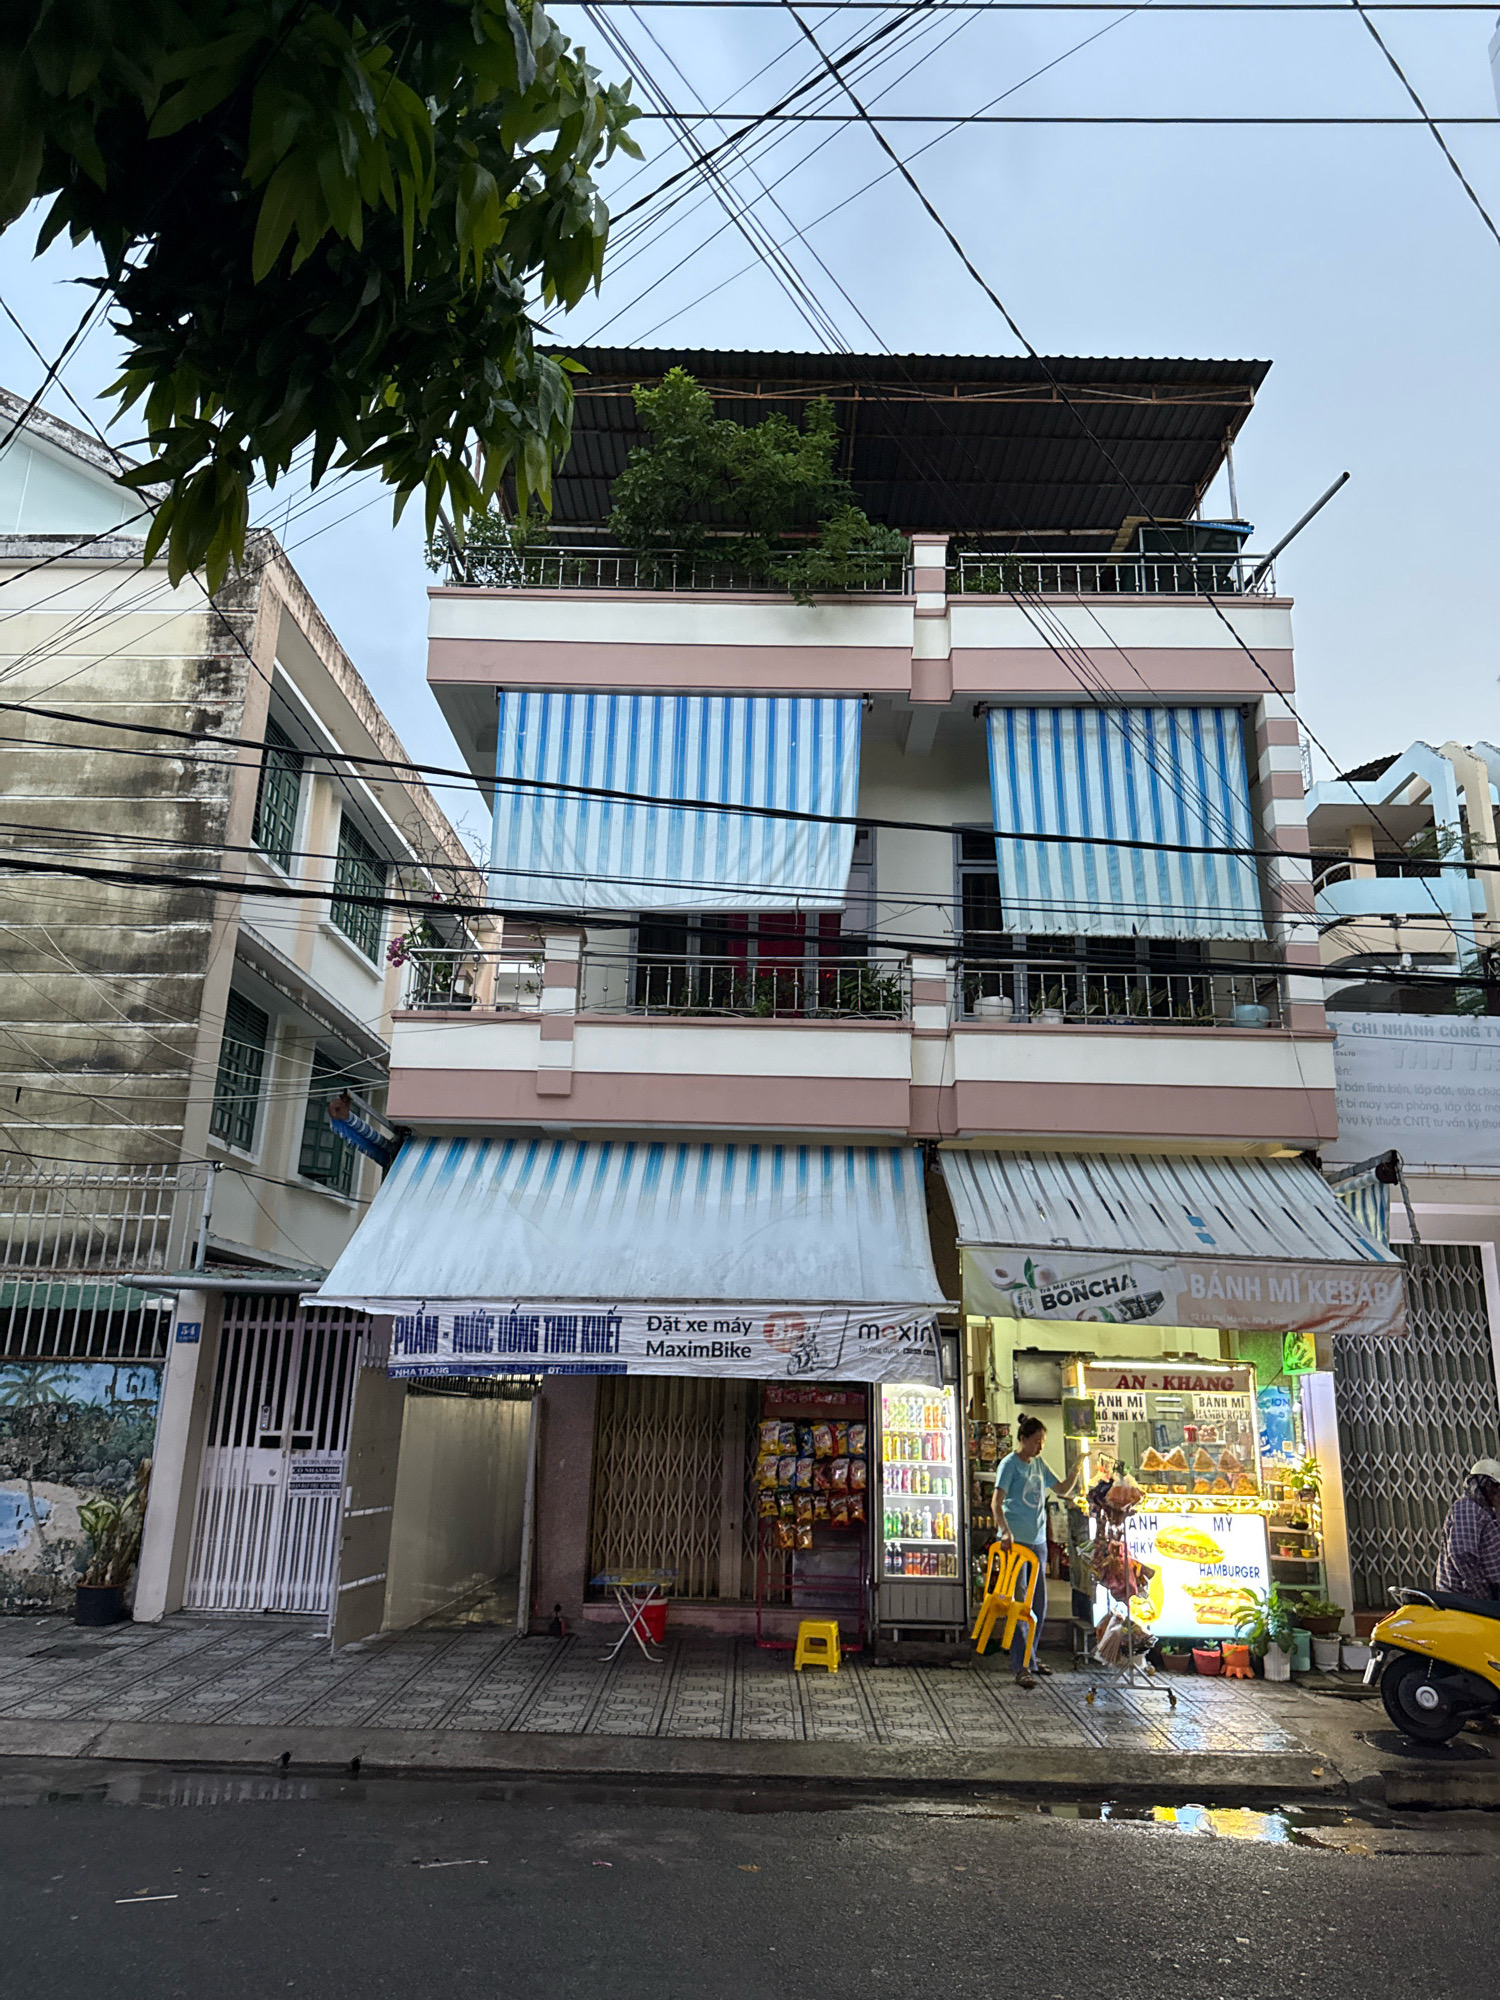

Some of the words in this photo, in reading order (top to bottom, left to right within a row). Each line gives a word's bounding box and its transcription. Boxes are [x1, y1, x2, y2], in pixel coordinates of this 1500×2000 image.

[1352, 1022, 1378, 1035] CHI
[1439, 1022, 1481, 1038] CÔNG
[1486, 1026, 1500, 1039] TY
[1344, 1081, 1365, 1093] bán
[1040, 1273, 1138, 1312] BONCHA
[1190, 1270, 1261, 1302] BÁNH
[1269, 1273, 1301, 1304] MÌ
[1307, 1279, 1390, 1307] KEBAB
[394, 1300, 439, 1354] PHẨM
[452, 1308, 494, 1353] NƯỚC
[498, 1303, 539, 1353] UỐNG
[543, 1315, 577, 1353] TINH
[580, 1305, 623, 1353] KHIẾT
[646, 1315, 681, 1336] Đặt
[686, 1320, 708, 1333] xe
[713, 1316, 753, 1337] máy
[646, 1340, 752, 1358] MaximBike
[418, 1366, 449, 1376] TRANG
[1116, 1374, 1147, 1390] AN
[1162, 1375, 1235, 1391] KHANG
[1093, 1392, 1122, 1408] ÁNH
[1198, 1395, 1228, 1408] BÁNH
[1195, 1408, 1250, 1420] HAMBURGER
[1199, 1564, 1260, 1579] HAMBURGER
